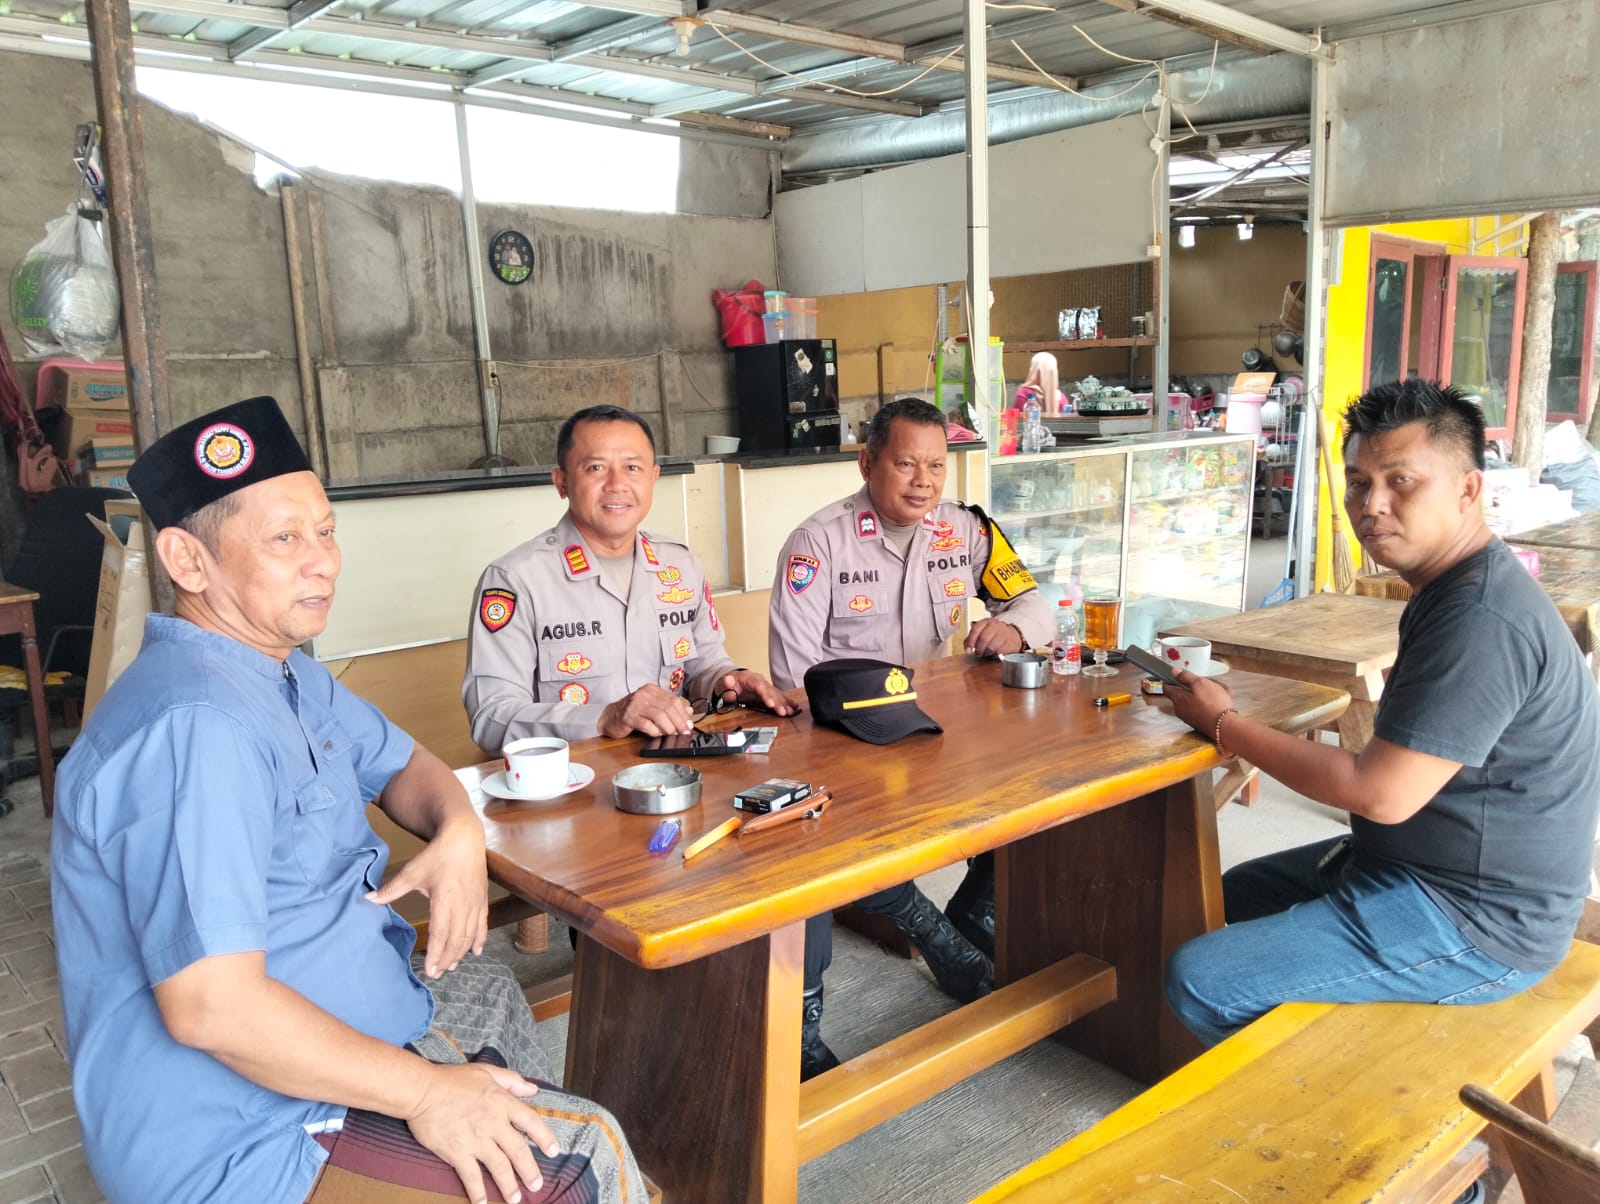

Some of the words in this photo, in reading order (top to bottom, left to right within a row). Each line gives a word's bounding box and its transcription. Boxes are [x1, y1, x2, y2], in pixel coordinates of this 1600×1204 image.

[927, 553, 972, 573] POLRI
[839, 569, 879, 585] BANI
[541, 619, 603, 641] AGUS.R
